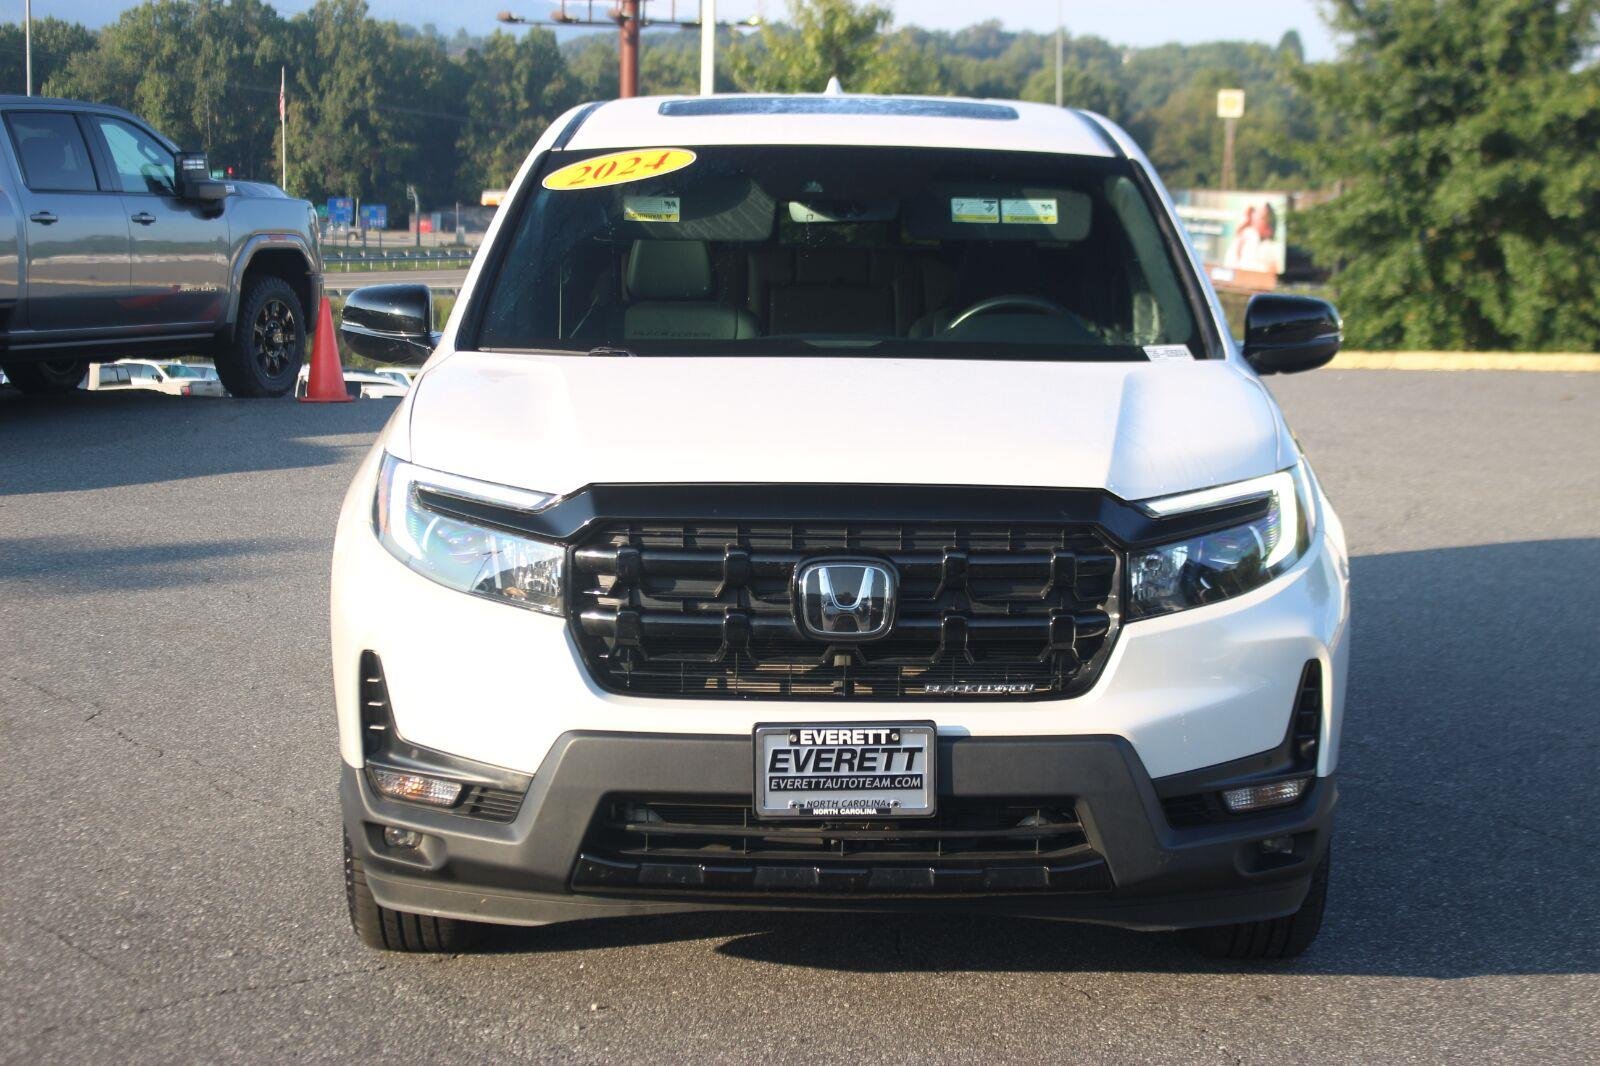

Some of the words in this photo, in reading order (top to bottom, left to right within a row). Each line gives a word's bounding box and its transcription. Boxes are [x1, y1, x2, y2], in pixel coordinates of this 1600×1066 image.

[567, 151, 671, 186] 2024
[800, 729, 891, 745] EVERETT
[768, 747, 924, 774] EVERETT
[770, 777, 922, 790] EVERETTAUTOTEAM.COM
[806, 799, 839, 808] NORTH
[841, 799, 887, 808] CAROLINA
